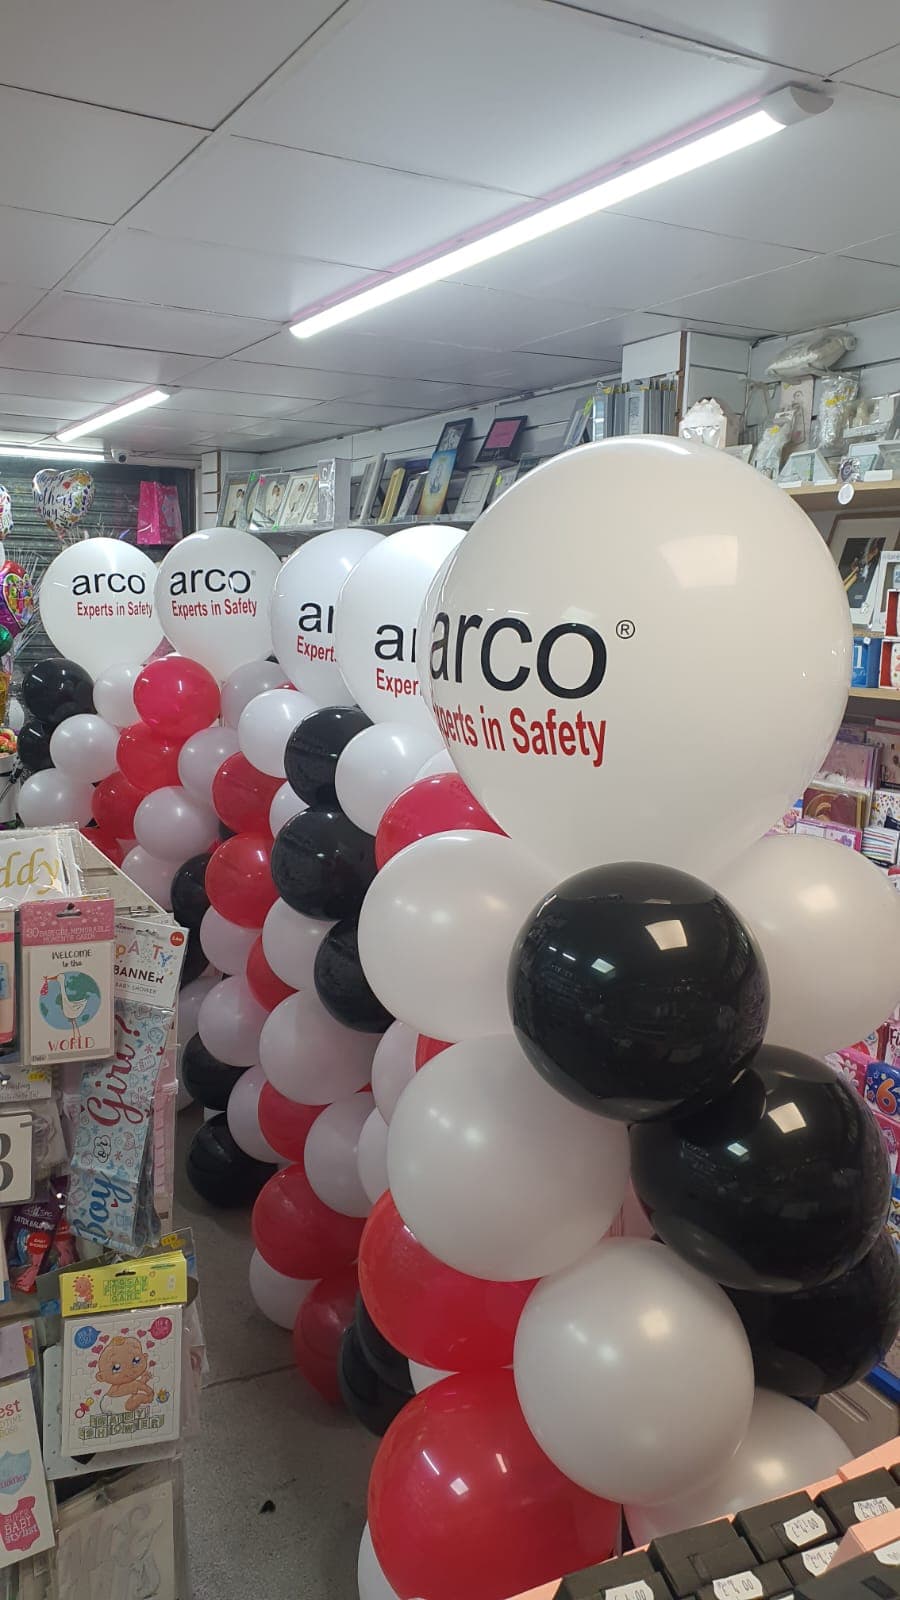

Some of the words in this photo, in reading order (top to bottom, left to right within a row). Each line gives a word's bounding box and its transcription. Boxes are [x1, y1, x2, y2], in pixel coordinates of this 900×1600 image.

[72, 572, 146, 596] arco
[170, 568, 251, 597] arco
[77, 602, 114, 620] Experts
[116, 602, 125, 616] in
[128, 601, 153, 618] Safety
[171, 600, 208, 620] Experts
[211, 599, 222, 616] in
[225, 597, 257, 617] Safety
[296, 635, 337, 662] Expert
[430, 612, 607, 699] arco
[479, 705, 506, 752] in
[509, 707, 607, 768] Safety
[52, 949, 93, 960] WELCOME
[115, 940, 172, 968] PATY
[876, 1078, 897, 1115] 6
[73, 1171, 132, 1242] Boy
